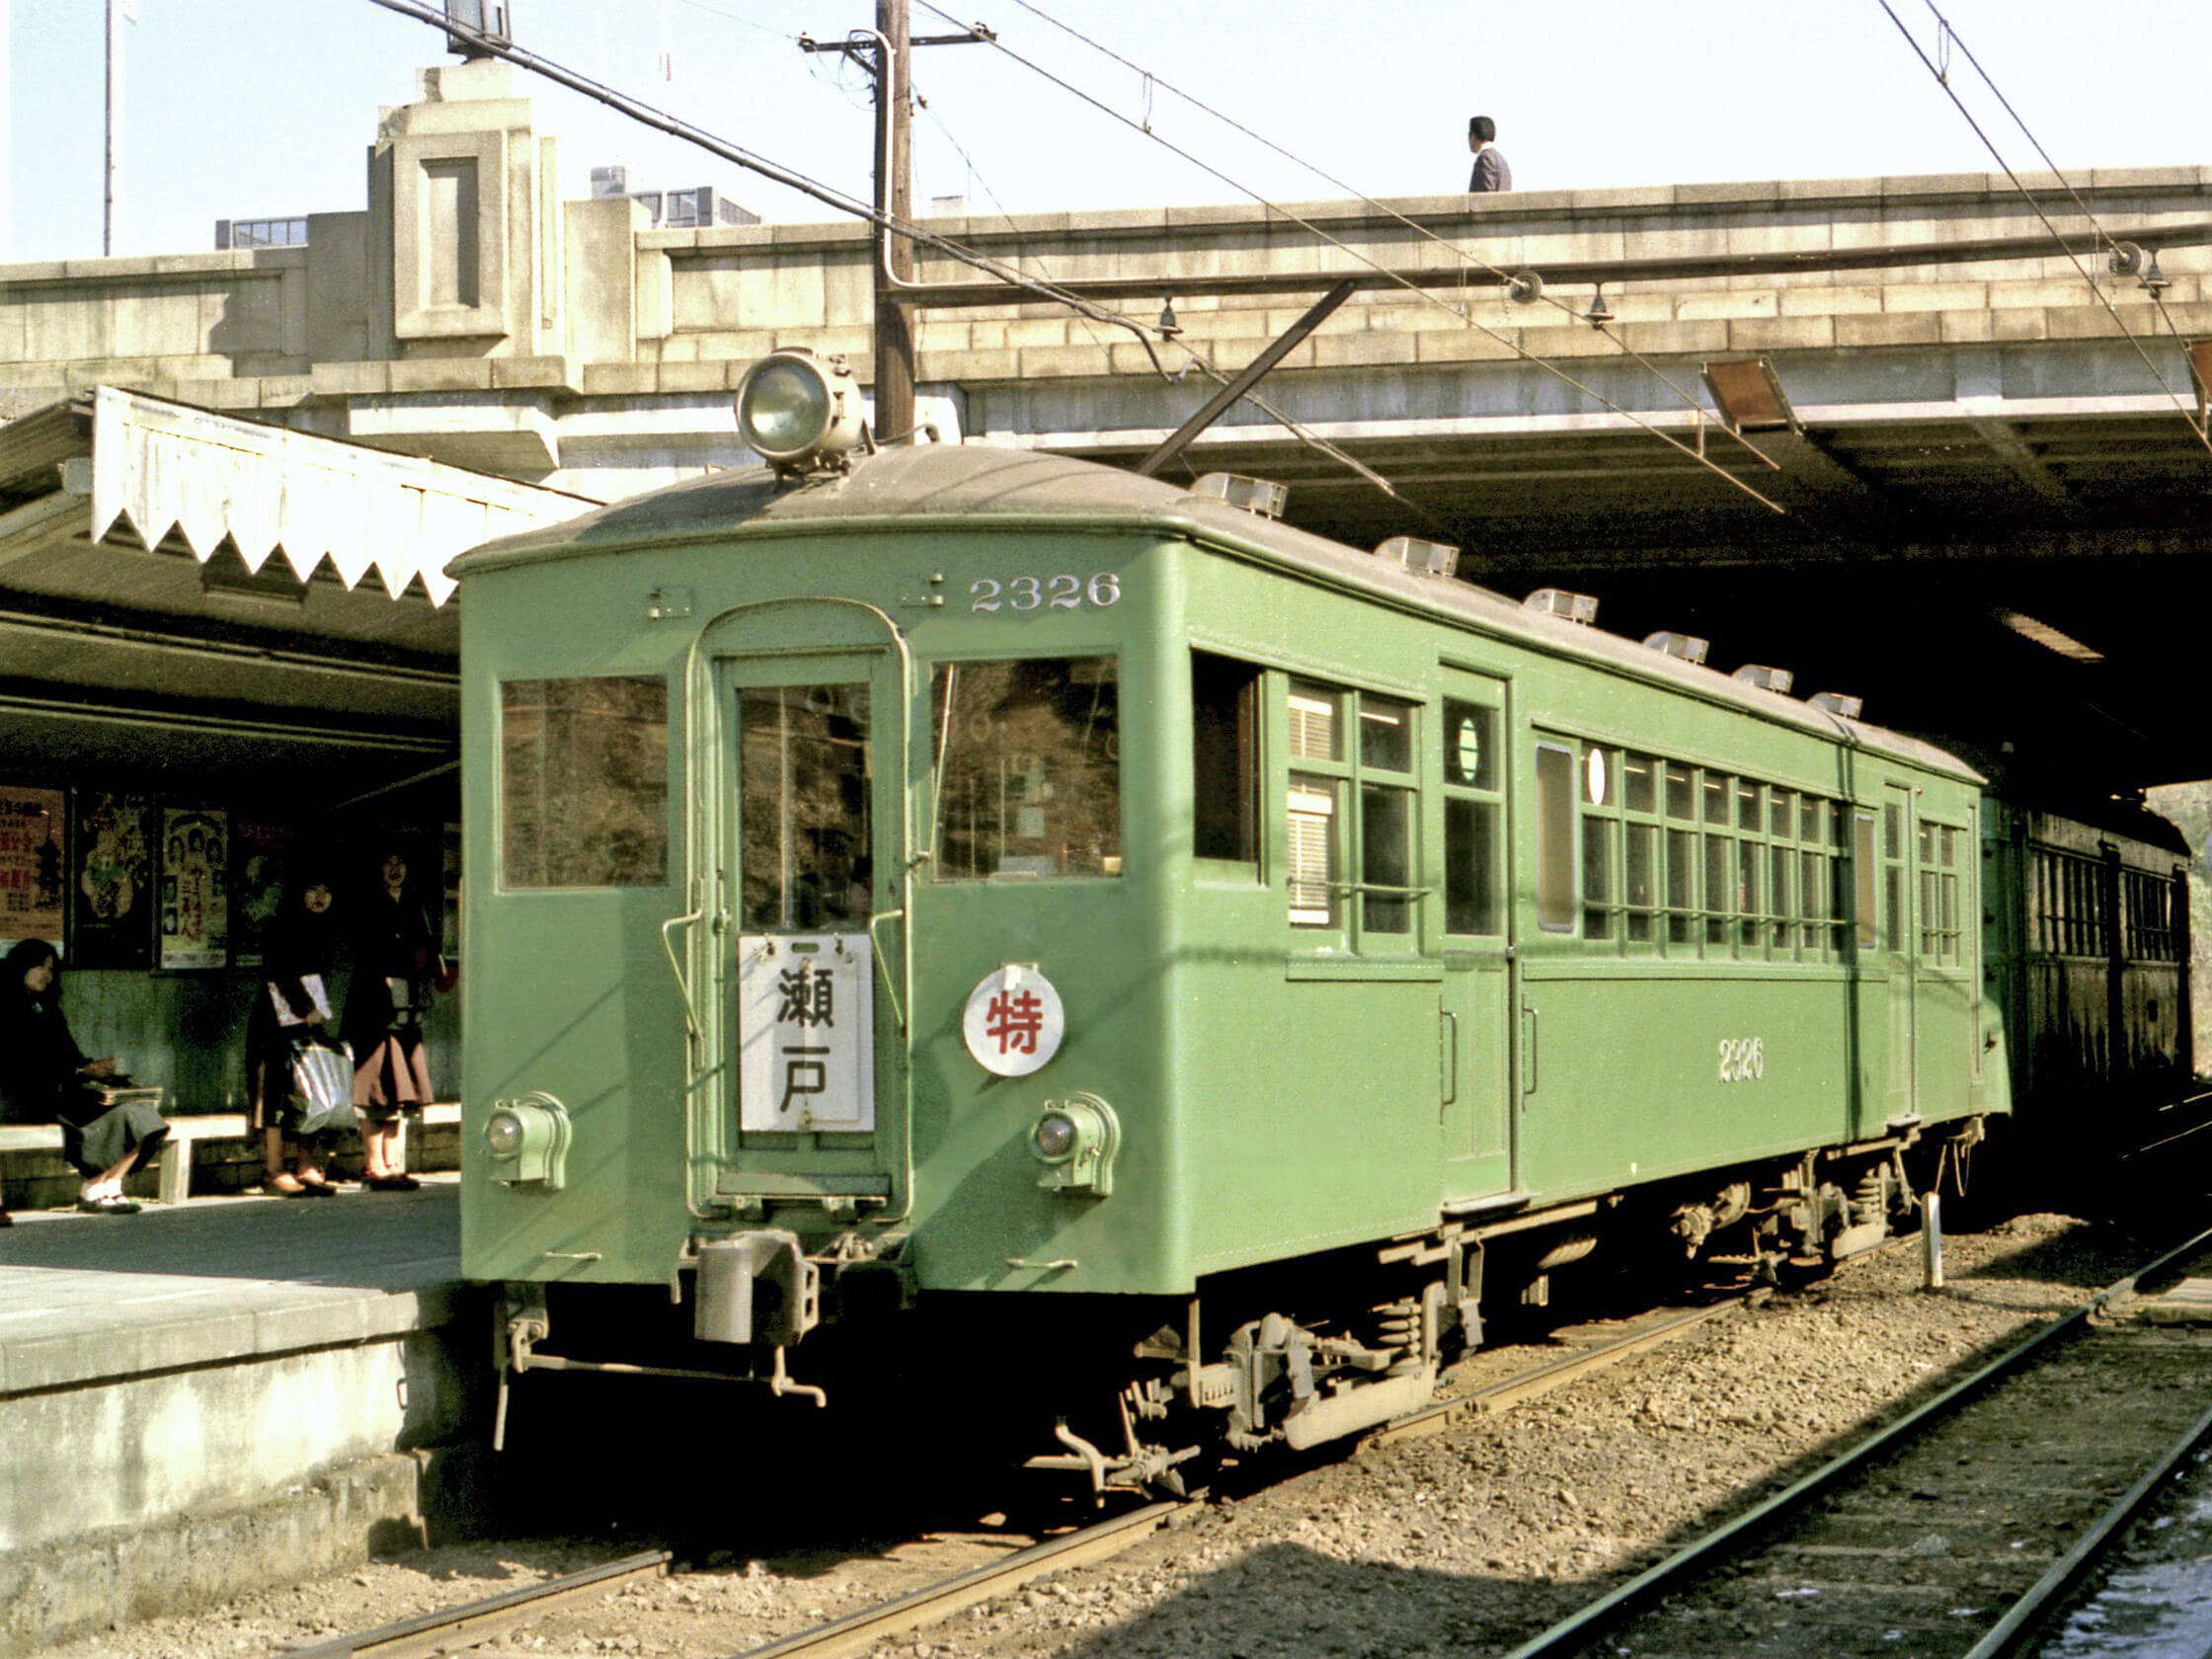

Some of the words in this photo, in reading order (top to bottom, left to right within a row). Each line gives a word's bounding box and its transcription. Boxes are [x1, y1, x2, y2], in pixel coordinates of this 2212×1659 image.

[970, 572, 1121, 612] 2326
[777, 968, 834, 1113] 瀬戸
[986, 989, 1043, 1055] 特
